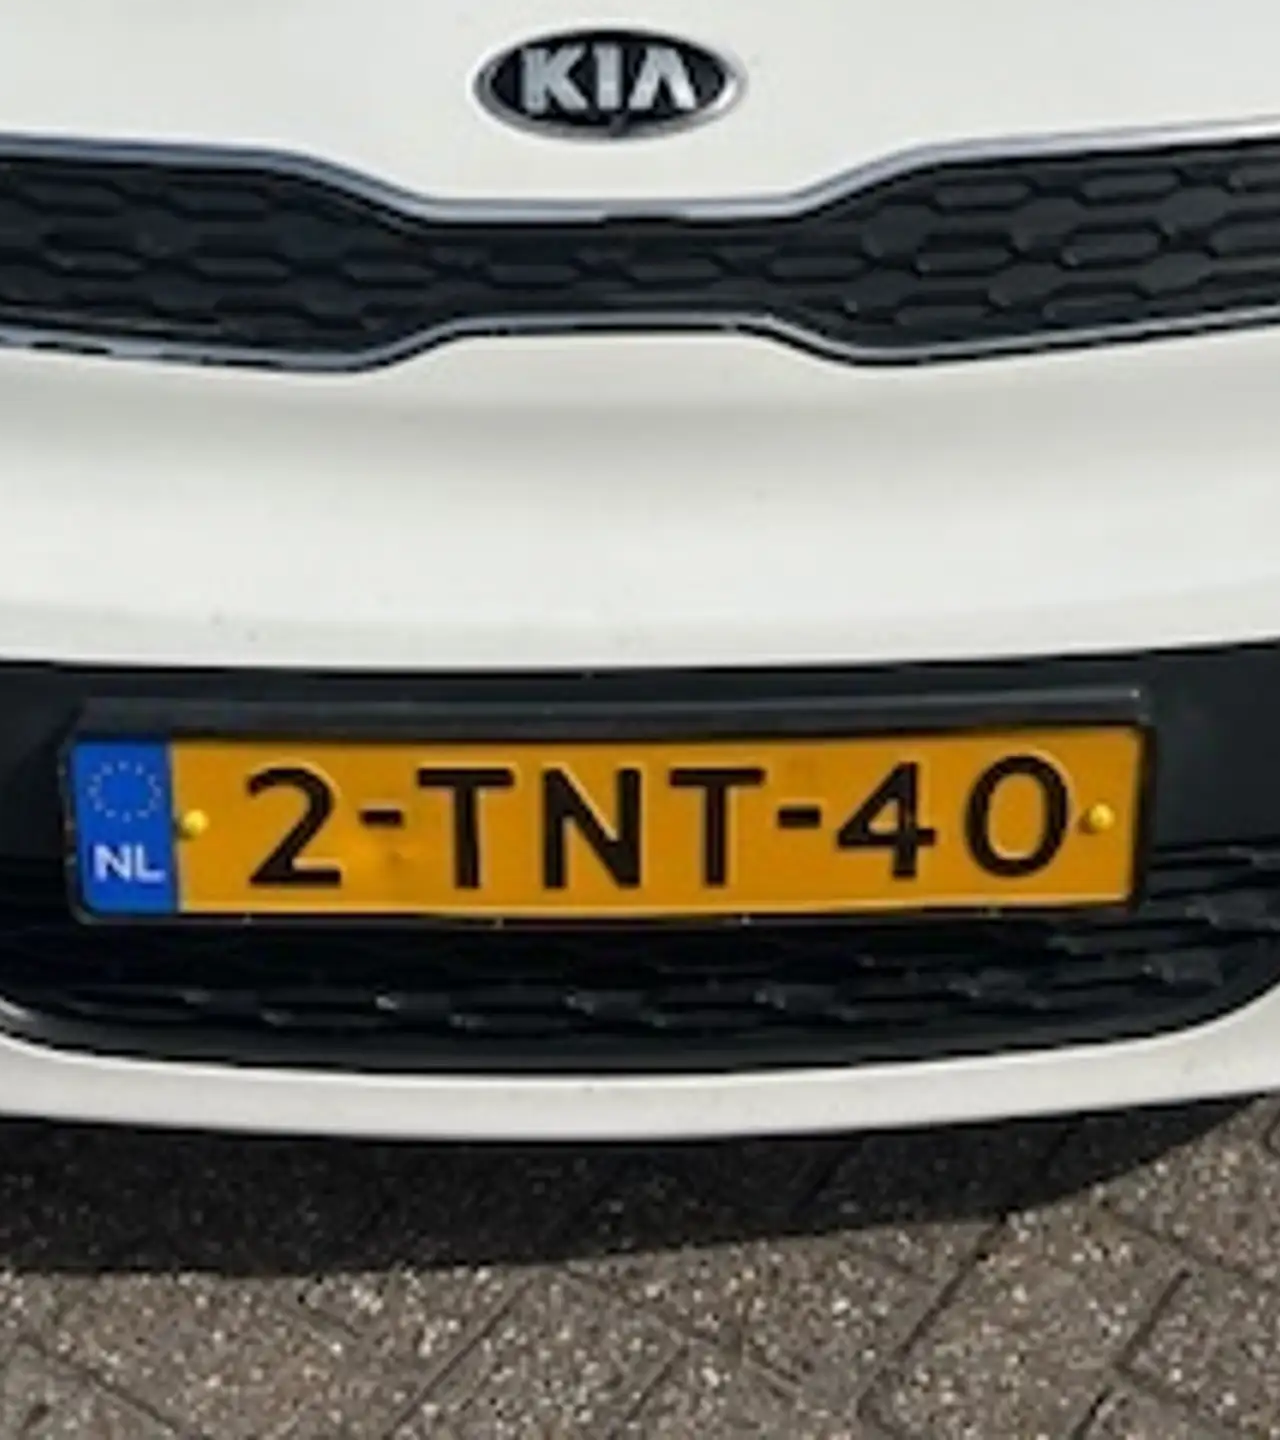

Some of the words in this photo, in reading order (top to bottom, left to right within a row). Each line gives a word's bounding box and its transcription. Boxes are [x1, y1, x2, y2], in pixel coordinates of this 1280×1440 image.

[522, 42, 697, 112] KIA
[245, 754, 1070, 889] 2-TNT-40
[93, 844, 166, 883] NL
